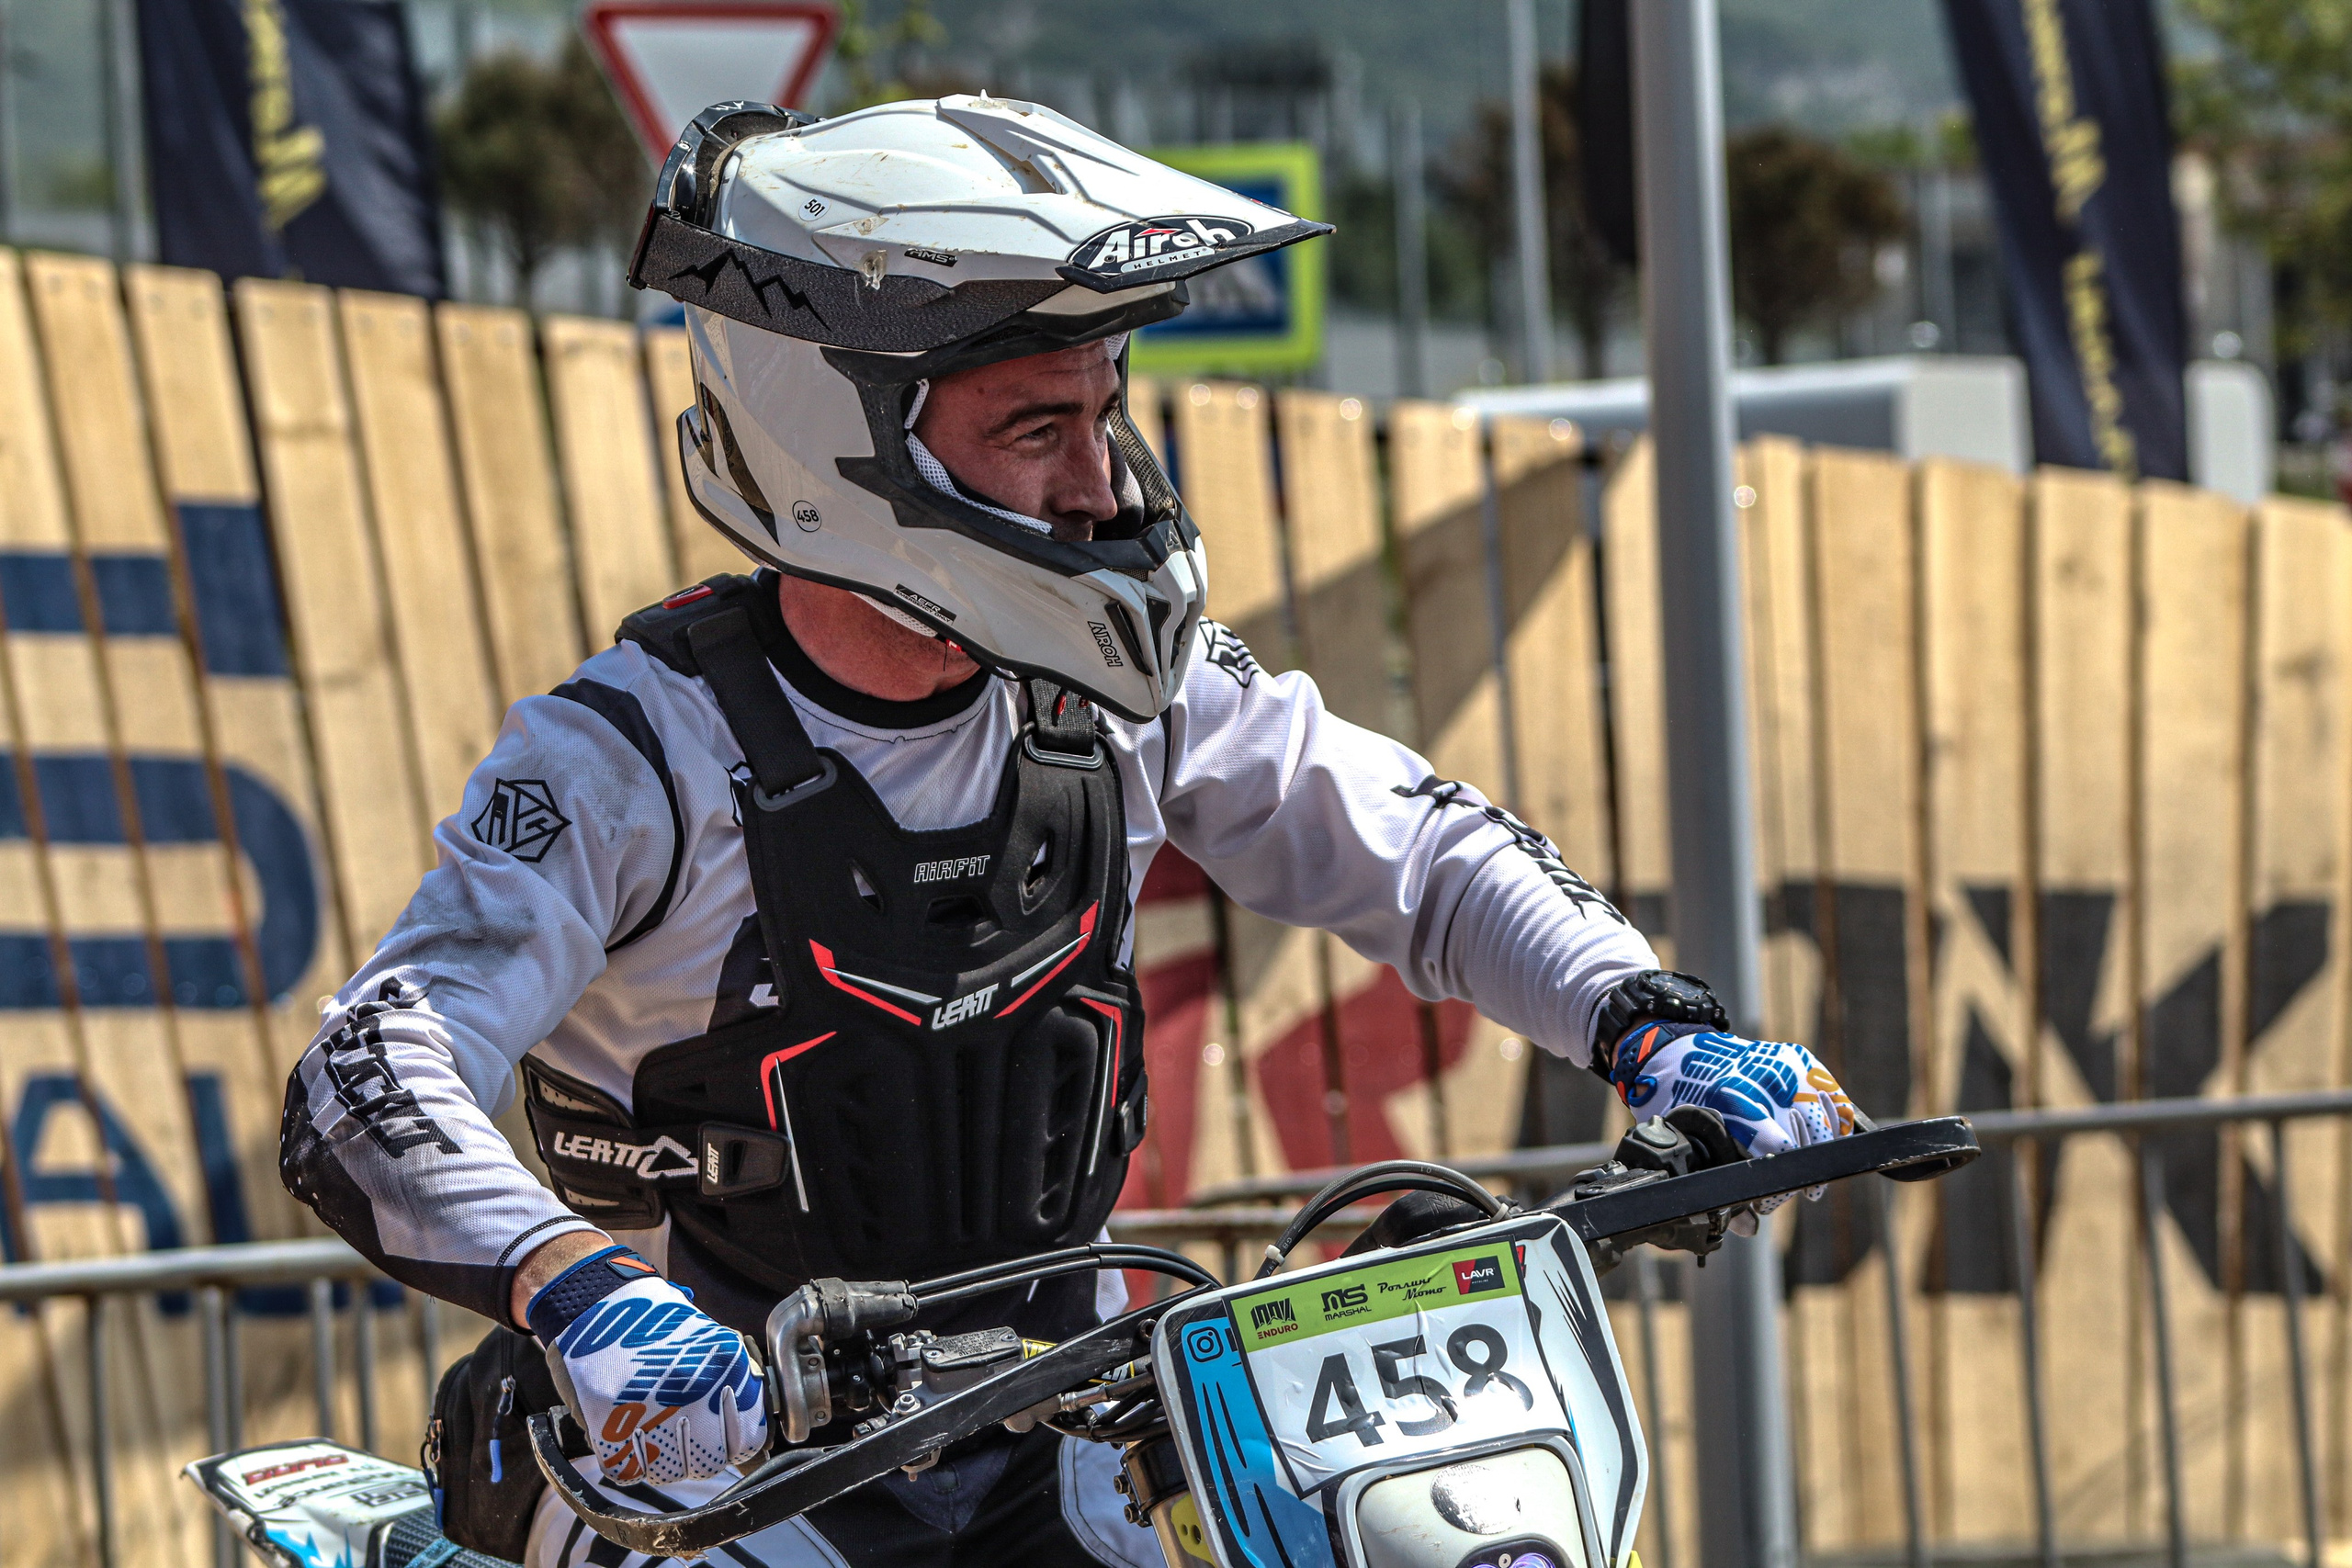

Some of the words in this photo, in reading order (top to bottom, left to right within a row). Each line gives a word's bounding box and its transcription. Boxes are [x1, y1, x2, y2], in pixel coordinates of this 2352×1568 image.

[804, 197, 825, 217] 501
[1088, 219, 1237, 270] Airoh
[1133, 249, 1202, 270] HELMET
[797, 509, 820, 523] 458
[895, 590, 933, 614] EMERGENCY
[933, 612, 951, 623] ONLY
[1087, 620, 1124, 667] AIROH
[931, 982, 1000, 1031] LEATT
[553, 1131, 654, 1169] LEATT
[707, 1142, 719, 1184] LEATT
[1461, 1268, 1495, 1280] LAVR
[1324, 1305, 1373, 1322] MARSHAL
[1257, 1323, 1299, 1340] ENDURO
[1306, 1323, 1534, 1448] 458
